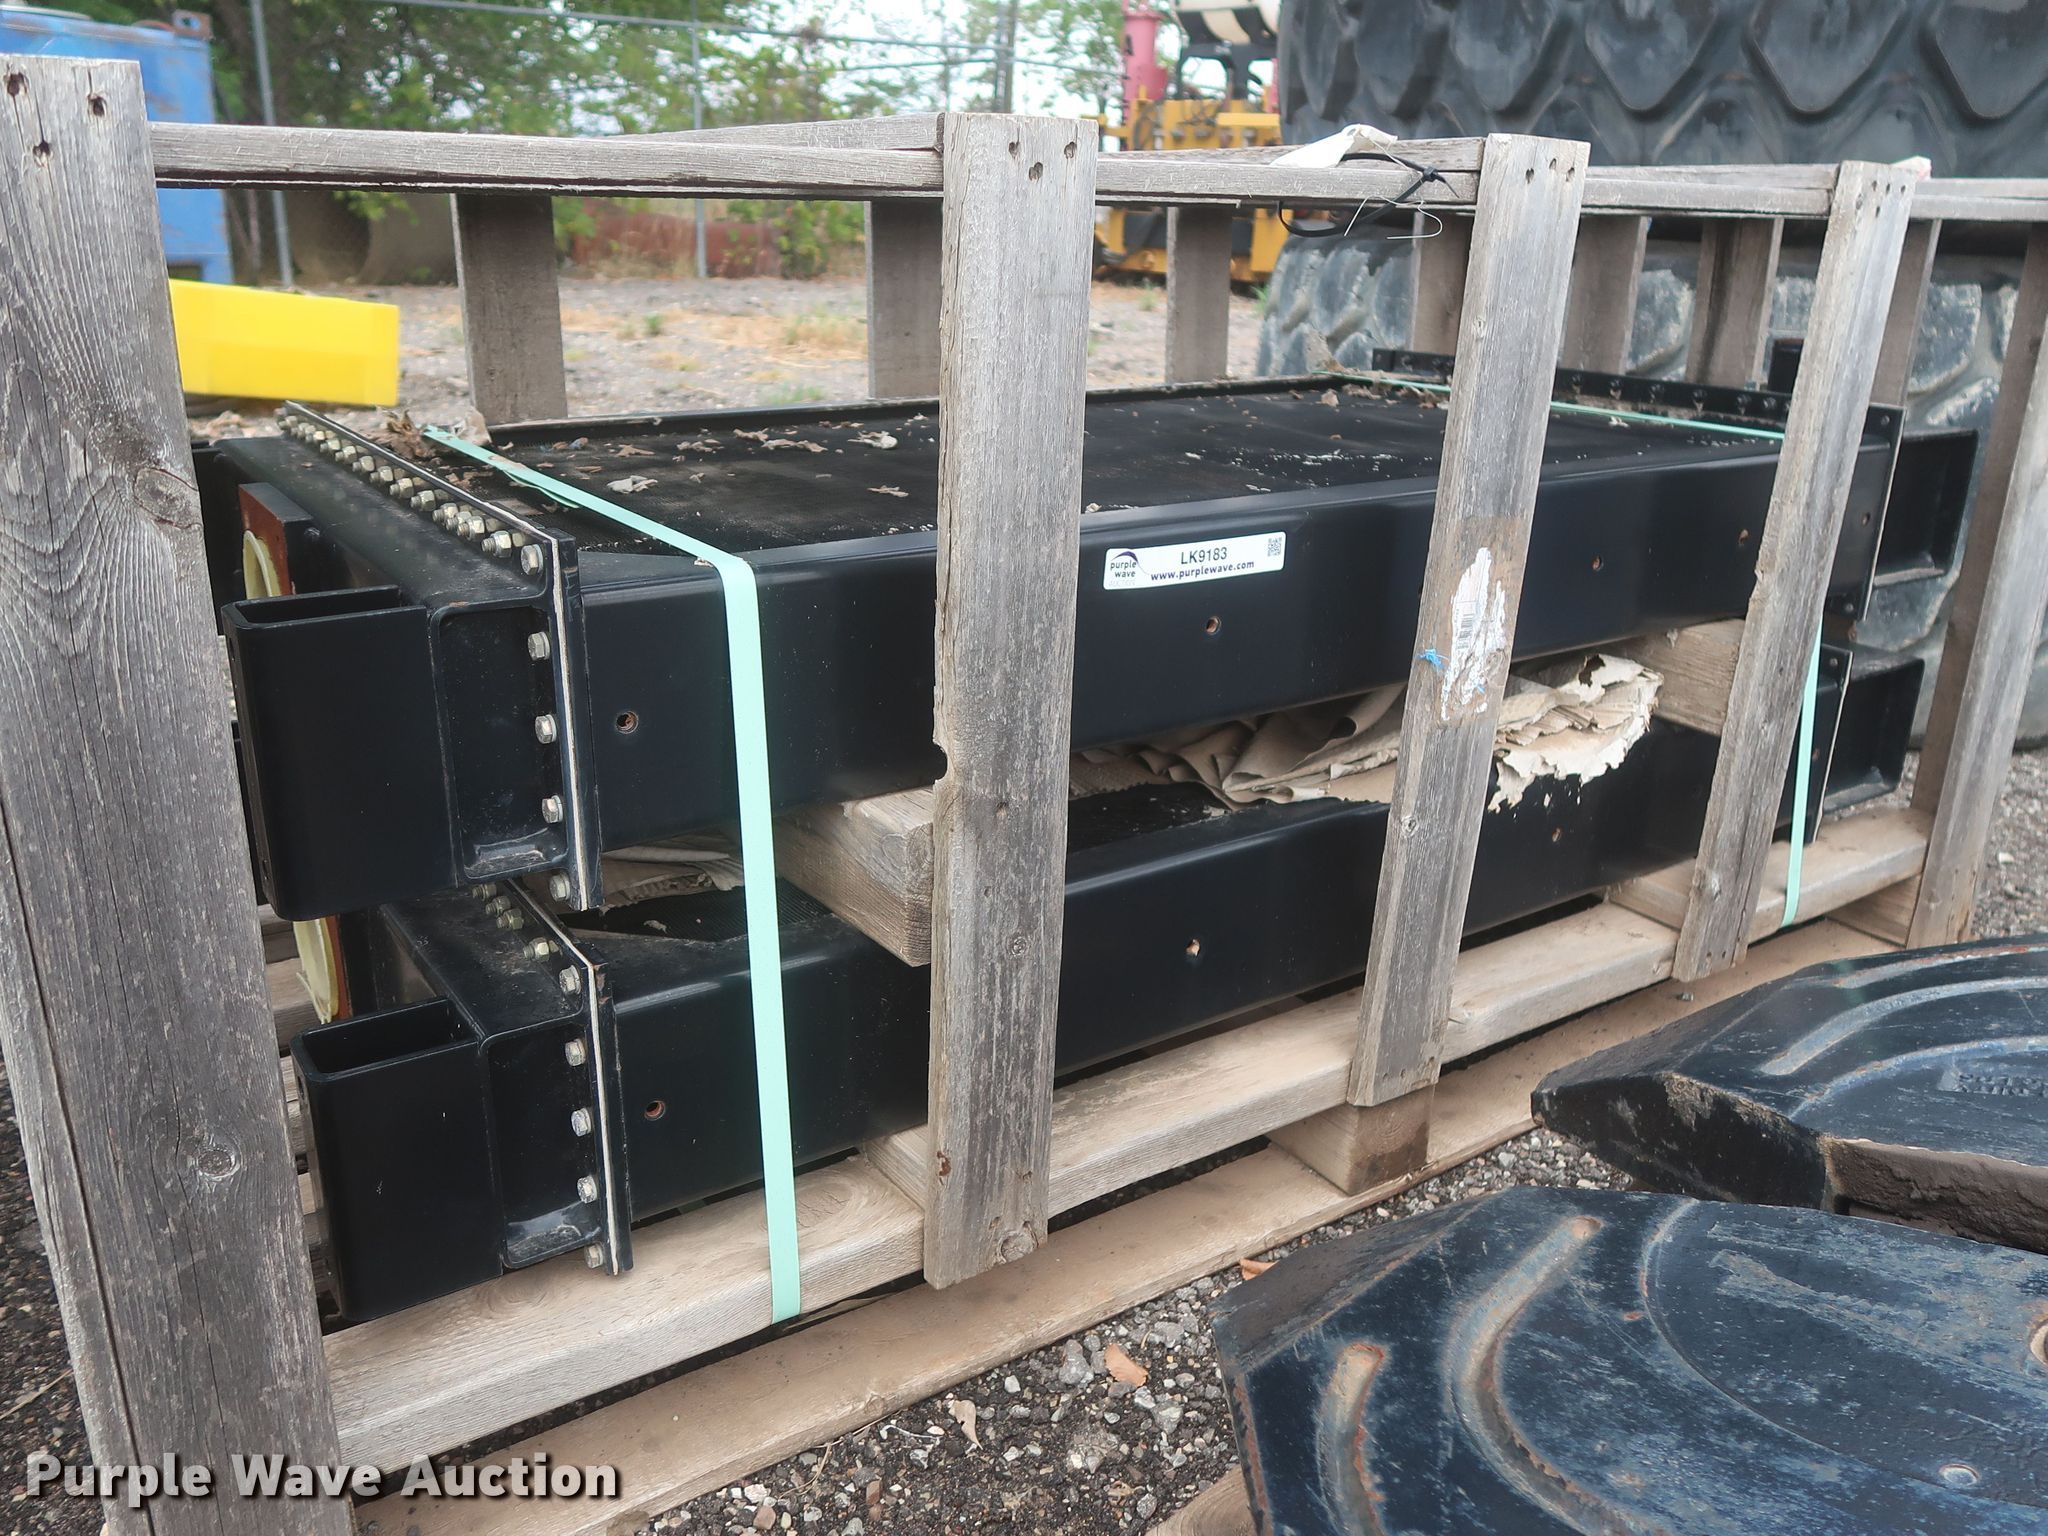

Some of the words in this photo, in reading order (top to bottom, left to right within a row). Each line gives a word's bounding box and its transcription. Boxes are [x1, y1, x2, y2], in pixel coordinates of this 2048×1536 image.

[1181, 547, 1228, 565] LK9183
[1110, 560, 1137, 571] purple
[1150, 560, 1255, 581] www.purplewave.com
[1114, 571, 1136, 579] wave
